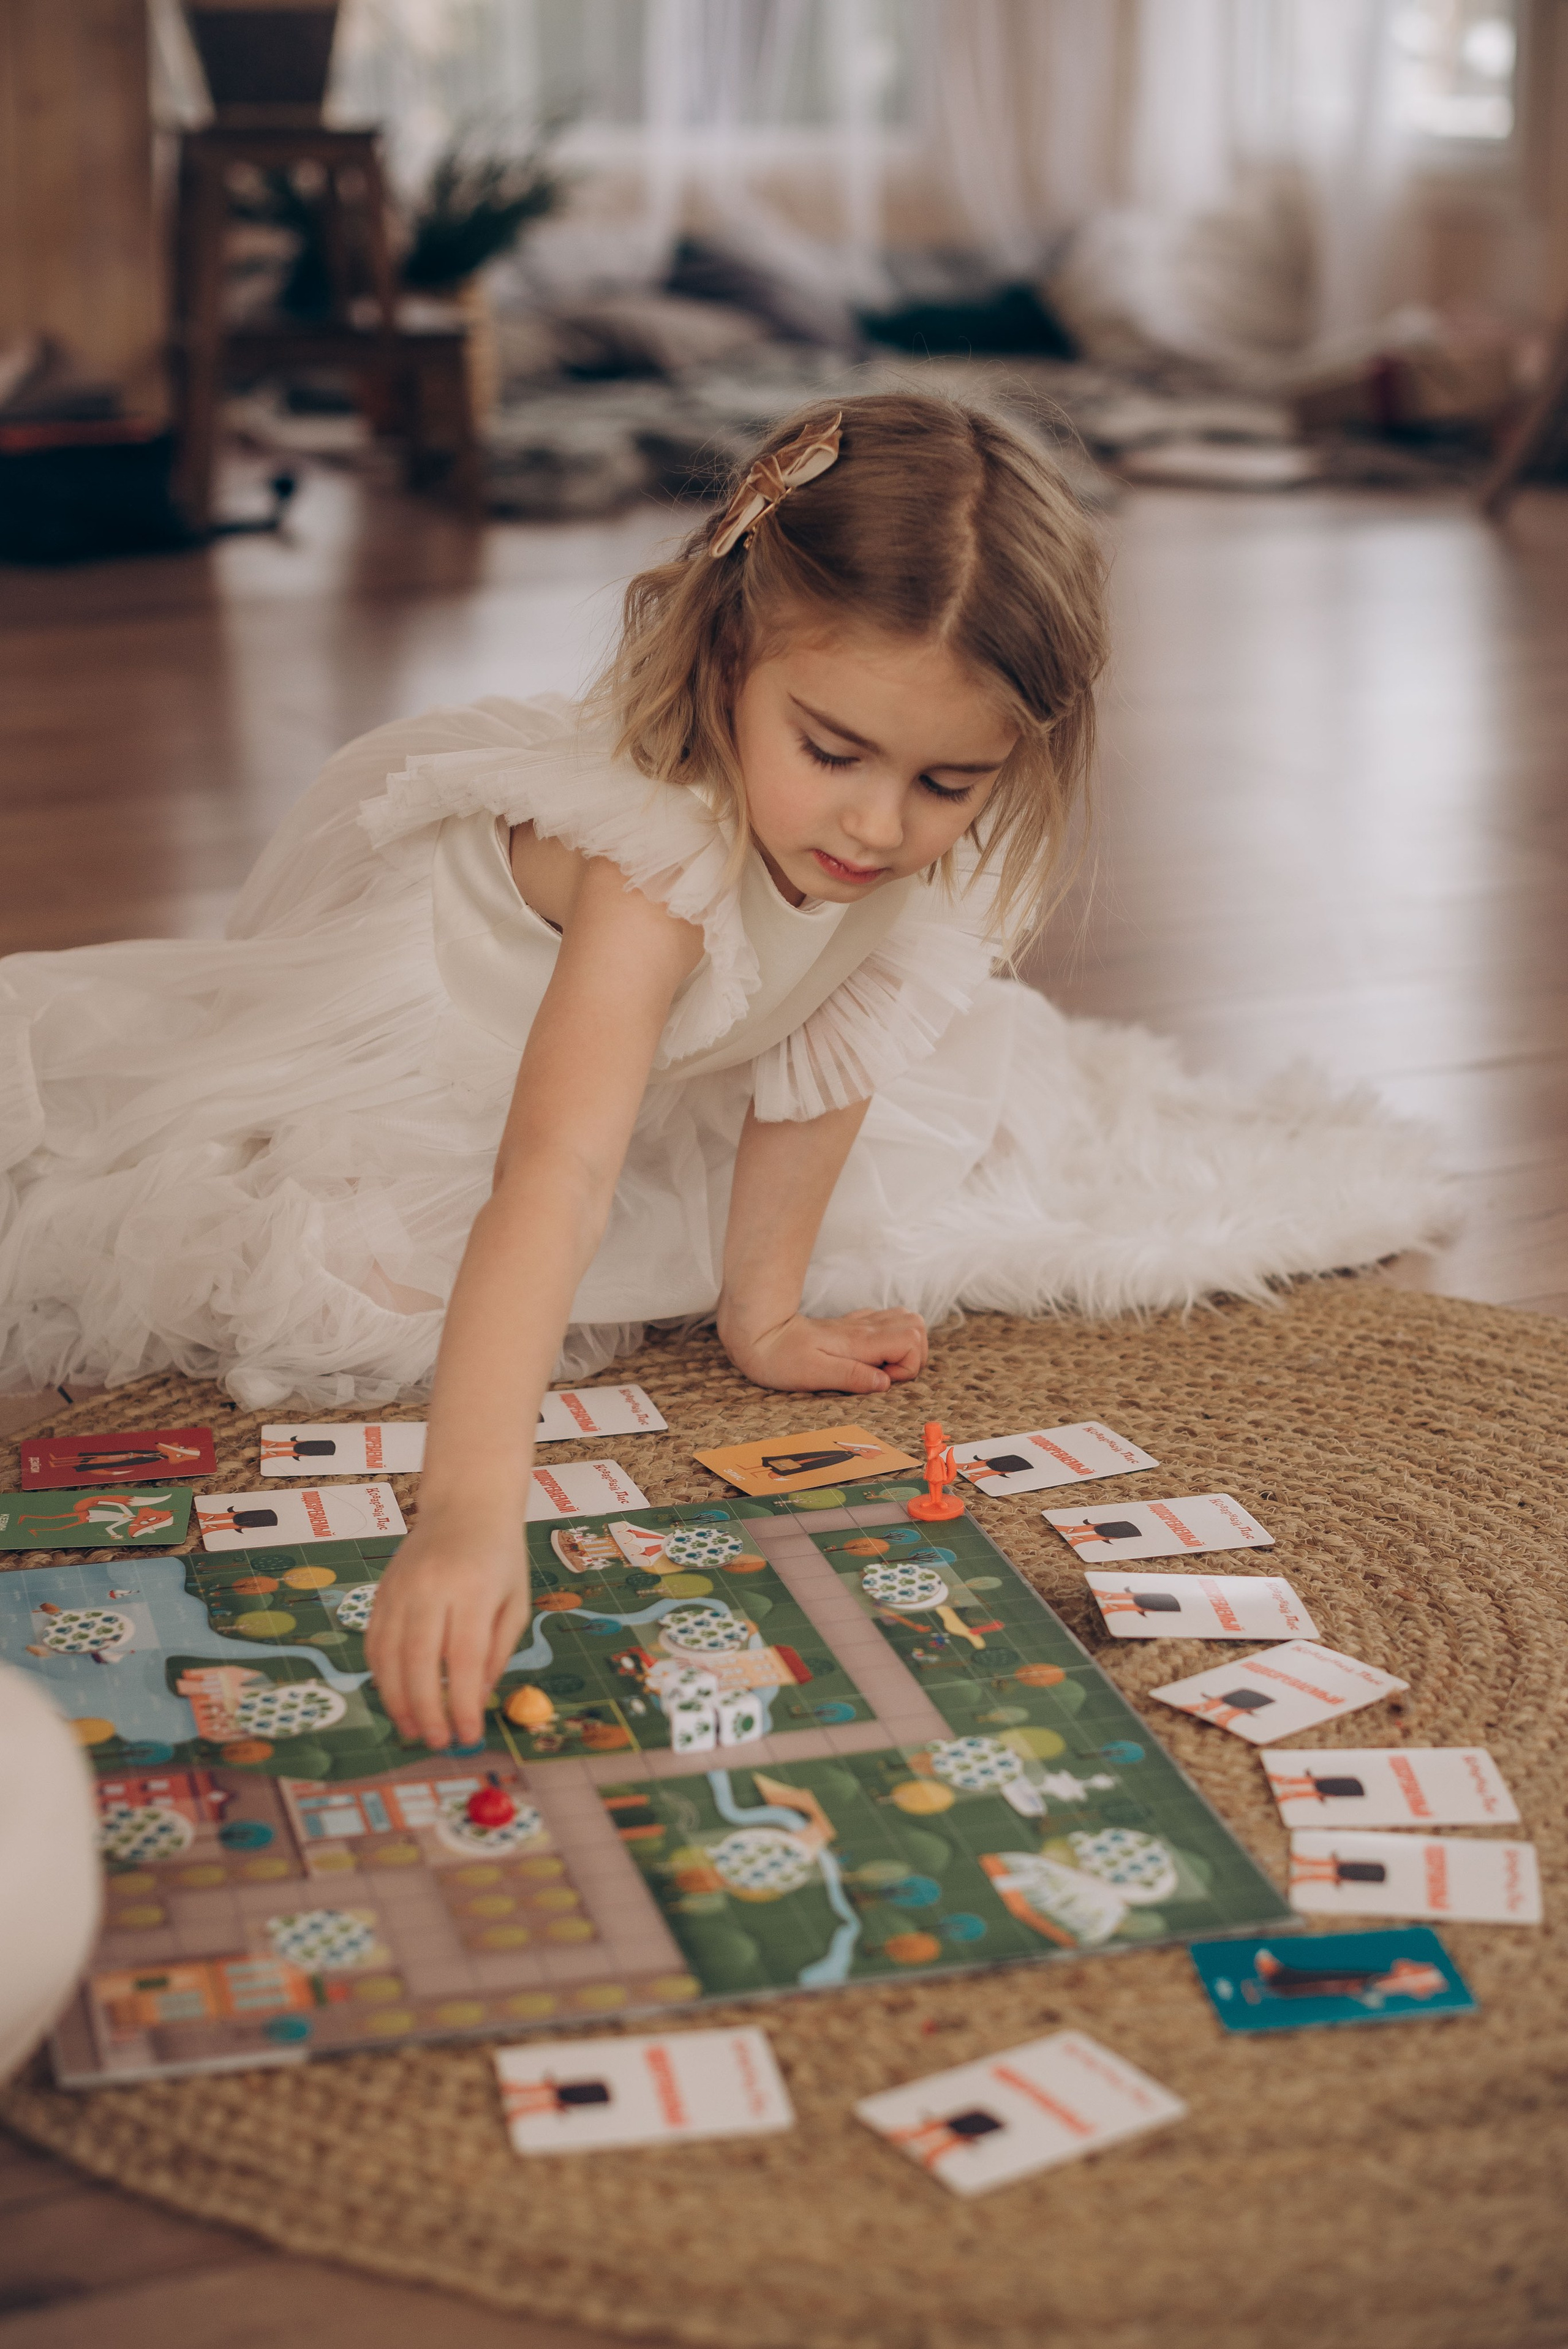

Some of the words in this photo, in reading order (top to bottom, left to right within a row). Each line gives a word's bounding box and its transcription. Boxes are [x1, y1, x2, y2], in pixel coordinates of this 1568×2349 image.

[636, 1414, 649, 1425] Лис
[1027, 1435, 1097, 1476] ПОДОЗРЕВАЕМЫЙ
[1082, 1427, 1122, 1452] Коварный
[1120, 1452, 1140, 1465] Лис
[532, 1469, 581, 1513] ПОДОЗРЕВАЕМЫЙ
[593, 1464, 619, 1491] Коварный
[614, 1491, 629, 1504] Лис
[723, 1468, 746, 1481] ЭЛИС
[301, 1491, 336, 1537] ПОДОЗРЕВАЕМЫЙ
[366, 1488, 385, 1517] Коварный
[377, 1517, 390, 1531] Лис
[1147, 1503, 1207, 1547] ПОДОЗРЕВАЕМЫЙ
[1208, 1498, 1243, 1526] Коварный
[1238, 1526, 1255, 1540] Лис
[1284, 1615, 1299, 1631] Лис
